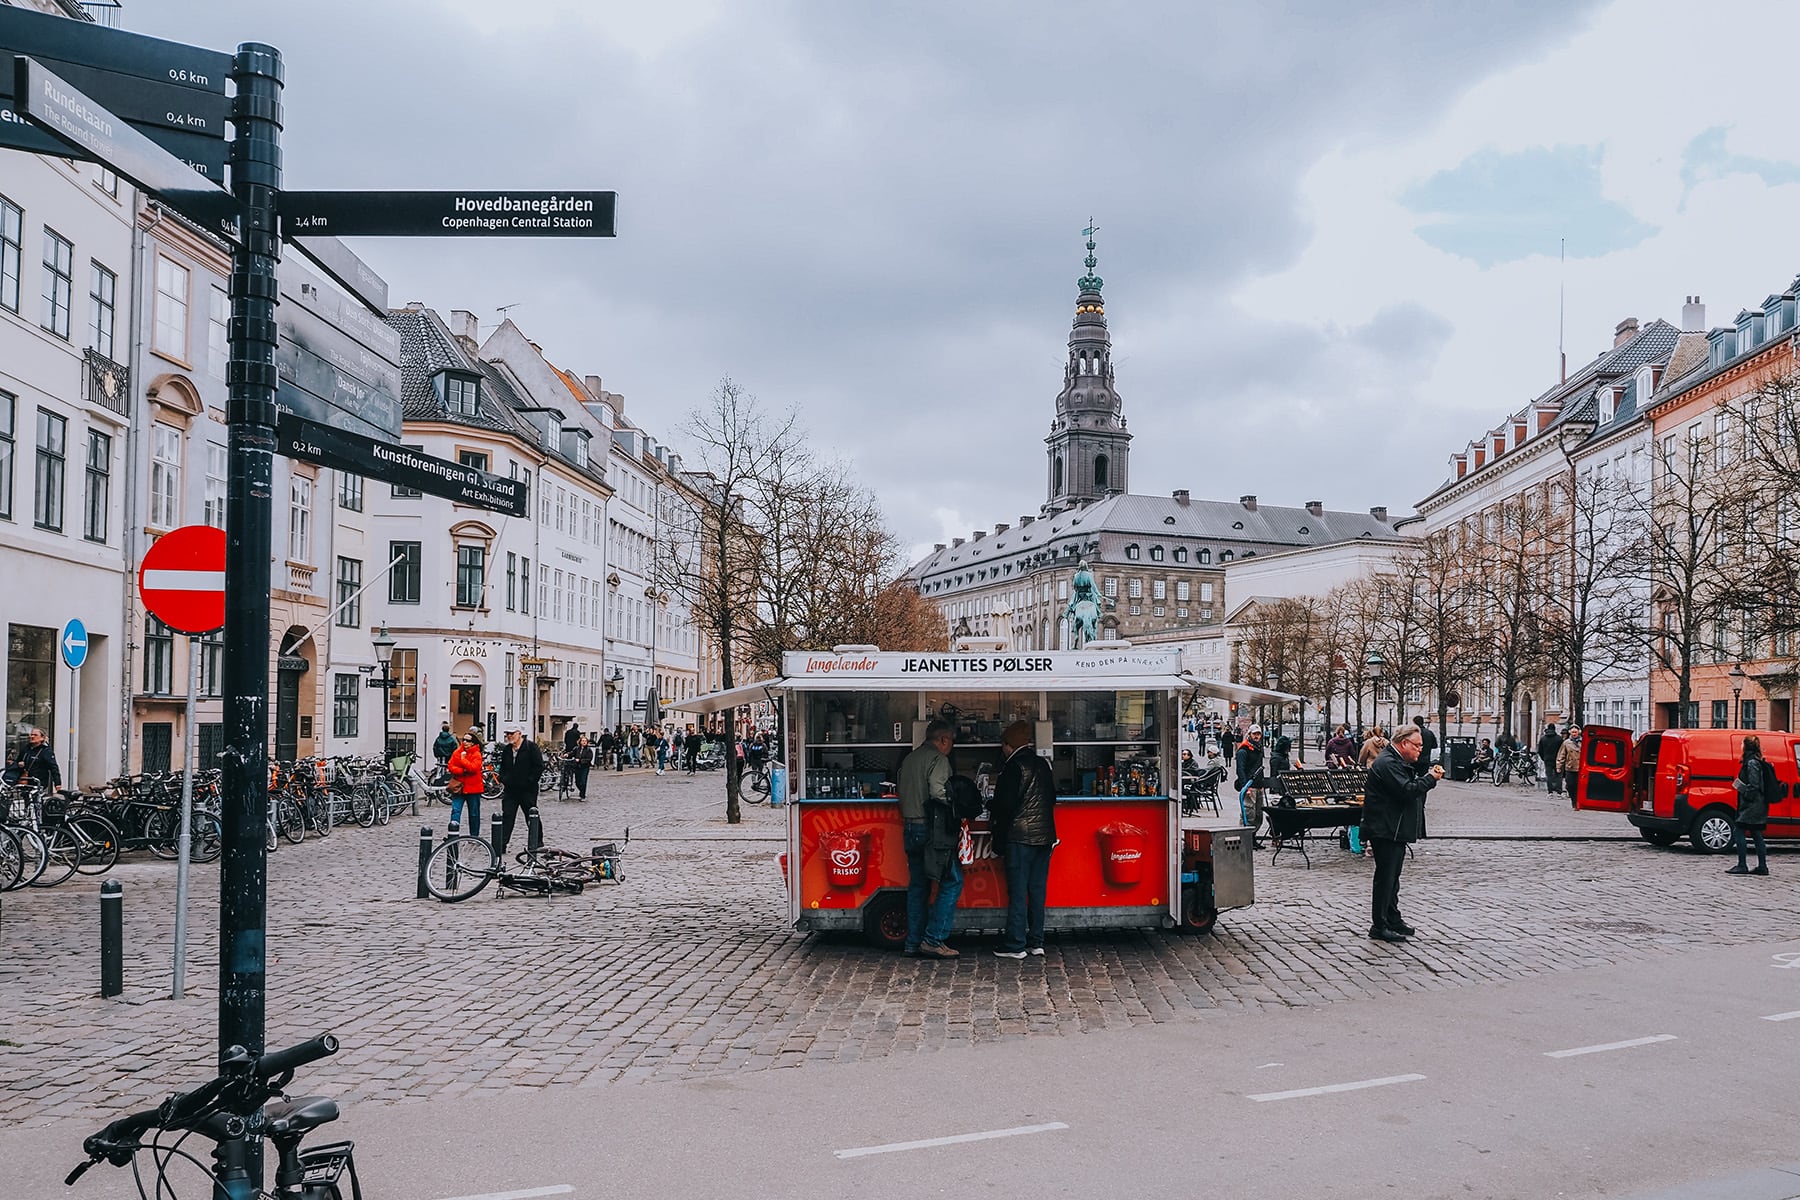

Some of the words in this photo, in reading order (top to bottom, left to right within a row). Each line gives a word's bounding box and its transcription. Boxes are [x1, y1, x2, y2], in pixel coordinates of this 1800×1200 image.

[169, 69, 187, 80] 0,6
[189, 71, 208, 85] km
[44, 80, 113, 138] Rundetaarn
[166, 112, 184, 124] 0,4
[187, 114, 206, 127] km
[61, 115, 89, 142] Round
[455, 196, 593, 214] Hovedbanegården
[295, 217, 309, 227] 1,4
[311, 215, 327, 226] km
[442, 216, 509, 229] Copenhagen
[511, 216, 551, 227] Central
[553, 216, 593, 228] Station
[292, 441, 306, 452] 0,2
[307, 442, 322, 456] km
[373, 444, 465, 482] Kunstforeningen
[466, 473, 480, 486] Gl.
[461, 487, 474, 498] Art
[474, 491, 514, 509] Exhibitions
[450, 645, 488, 658] SCARPA
[806, 657, 878, 673] Langelænder
[901, 658, 988, 672] JEANETTES
[992, 657, 1053, 672] PØLSER
[1099, 658, 1115, 666] DEN
[833, 867, 860, 876] FRISKO
